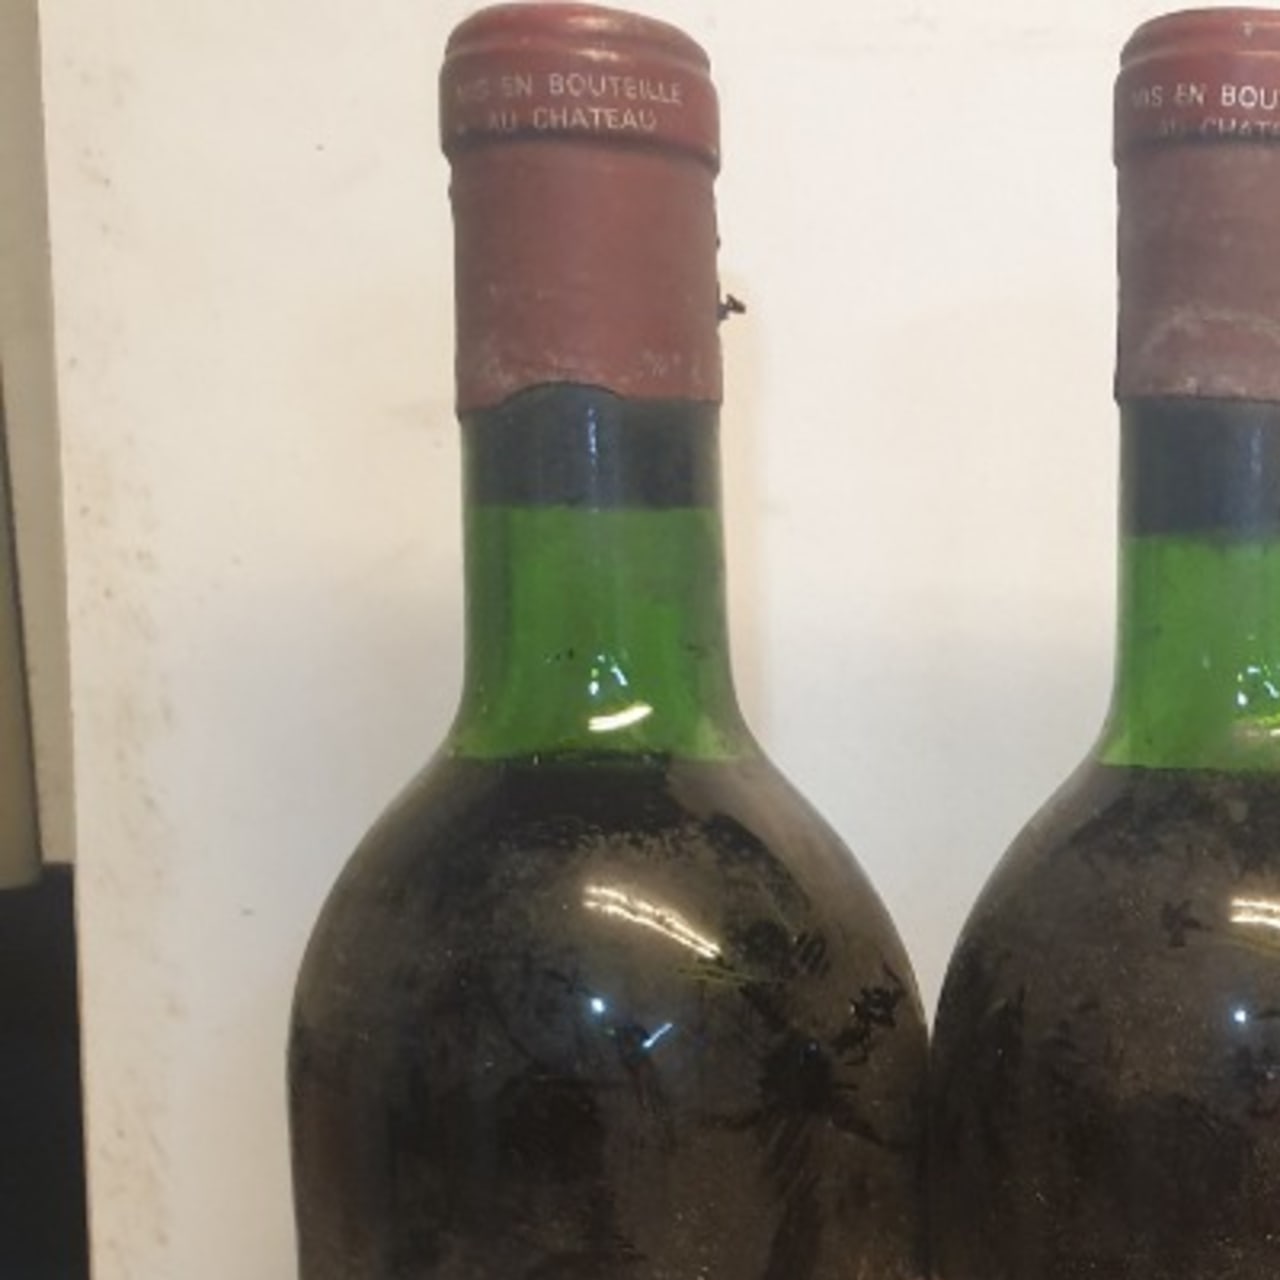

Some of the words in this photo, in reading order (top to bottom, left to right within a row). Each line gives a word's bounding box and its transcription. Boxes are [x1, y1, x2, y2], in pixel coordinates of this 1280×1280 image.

[501, 76, 532, 97] EN
[549, 72, 682, 104] BOUTEILLE
[1176, 83, 1206, 105] EN
[533, 107, 657, 131] CHATEAU
